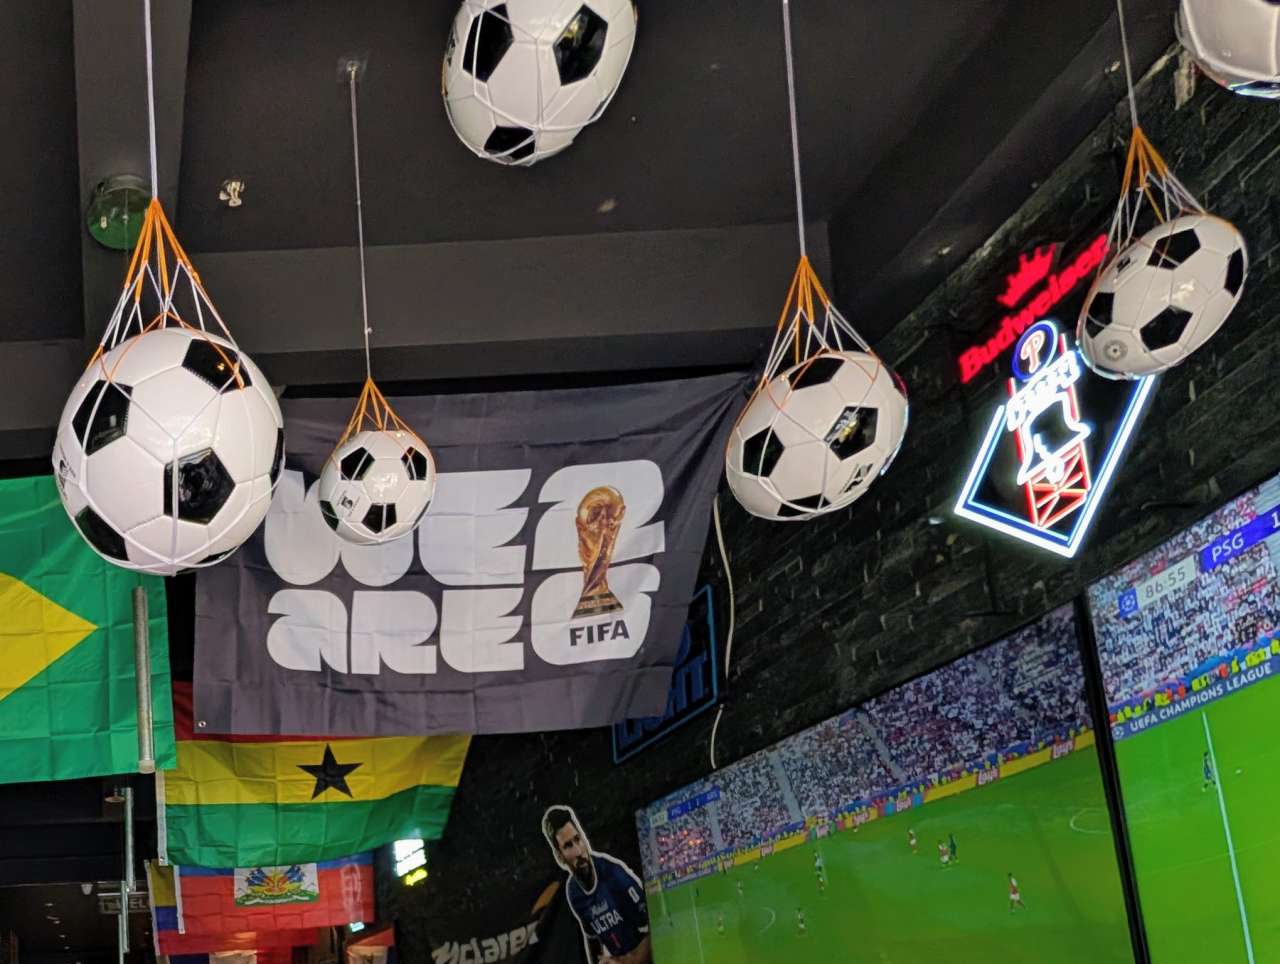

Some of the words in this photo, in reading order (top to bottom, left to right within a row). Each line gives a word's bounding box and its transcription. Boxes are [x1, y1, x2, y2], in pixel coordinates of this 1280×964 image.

[1212, 532, 1245, 562] PSG
[1145, 566, 1186, 599] 86:55
[266, 587, 524, 675] ARE
[569, 618, 630, 647] FIFA
[1129, 713, 1158, 732] UEFA
[1160, 685, 1223, 720] CHAMPIONS
[1226, 664, 1272, 691] LEAGUE
[590, 909, 624, 935] ULTRA
